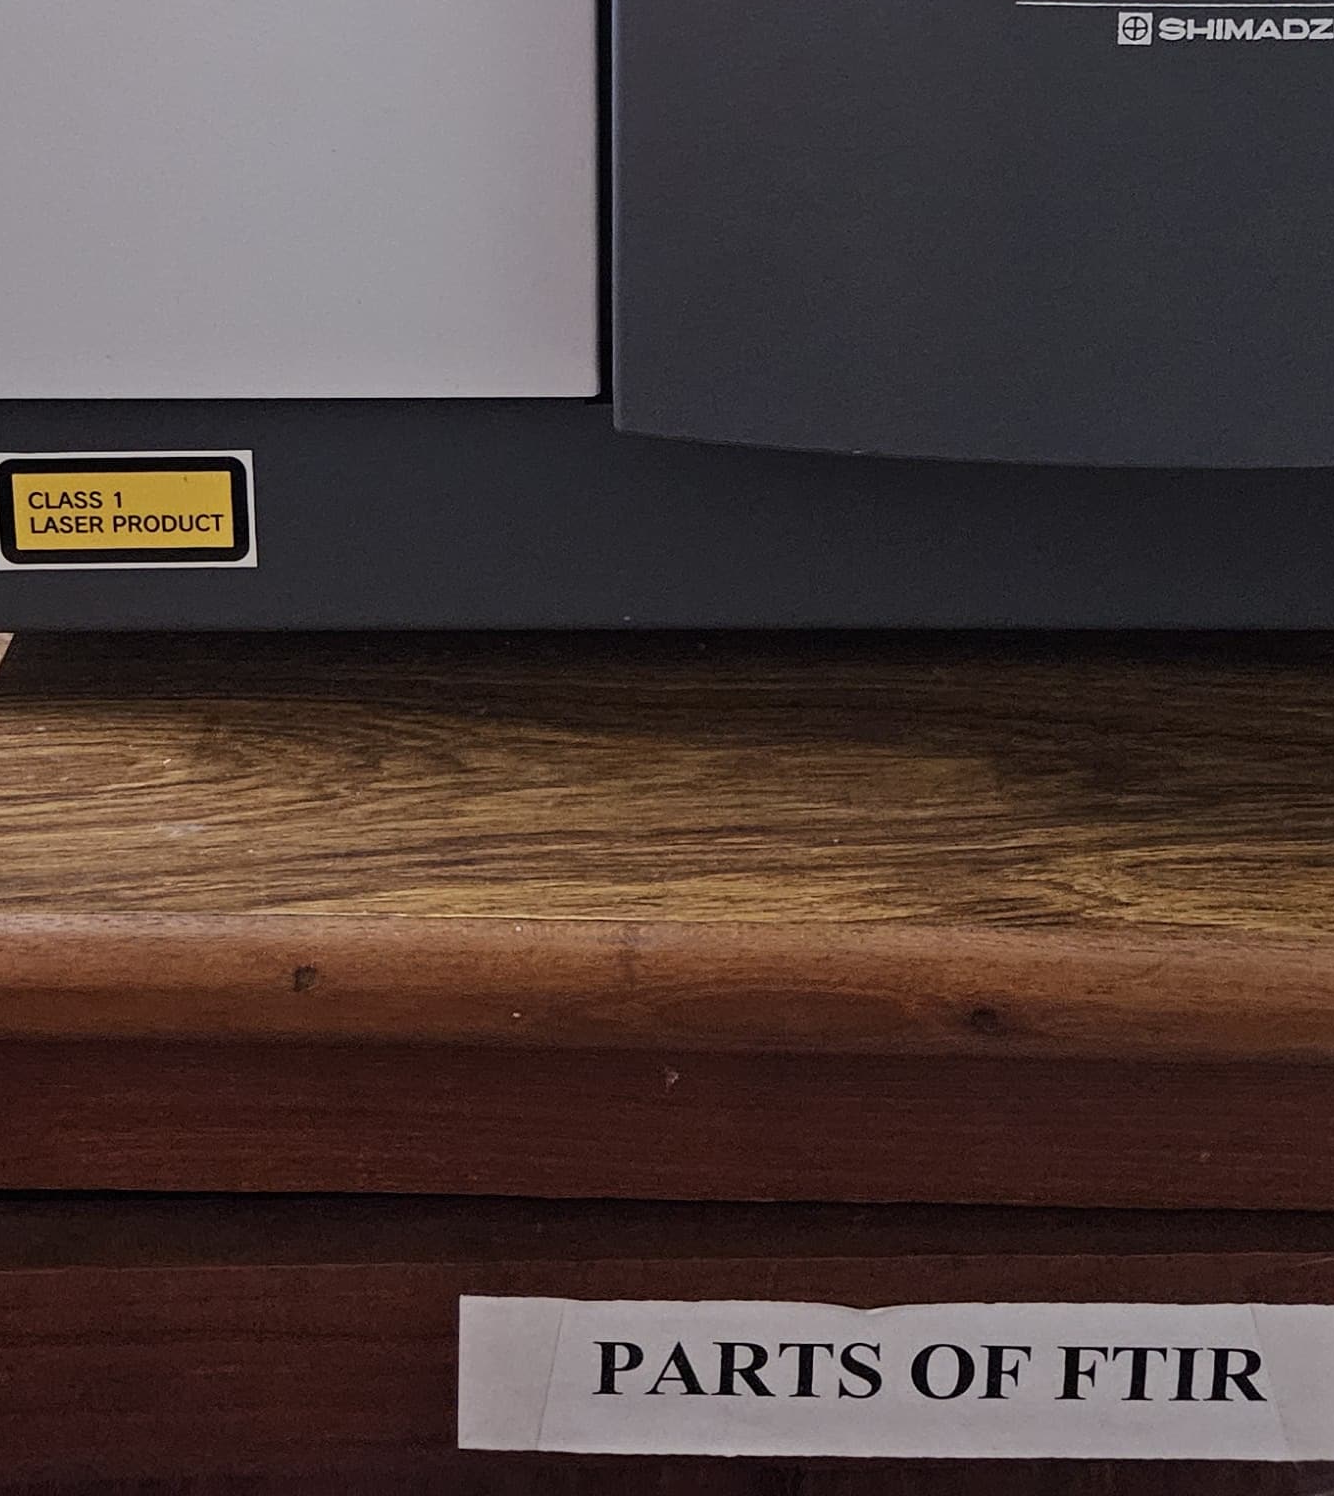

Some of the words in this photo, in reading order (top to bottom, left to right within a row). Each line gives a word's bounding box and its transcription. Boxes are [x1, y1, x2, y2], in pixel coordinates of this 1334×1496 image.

[28, 491, 103, 509] CLASS
[113, 491, 122, 508] 1
[30, 515, 104, 534] LASER
[112, 514, 225, 533] PRODUCT
[592, 1340, 884, 1400] PARTS
[911, 1342, 1033, 1401] OF
[1055, 1345, 1268, 1403] FTIR
